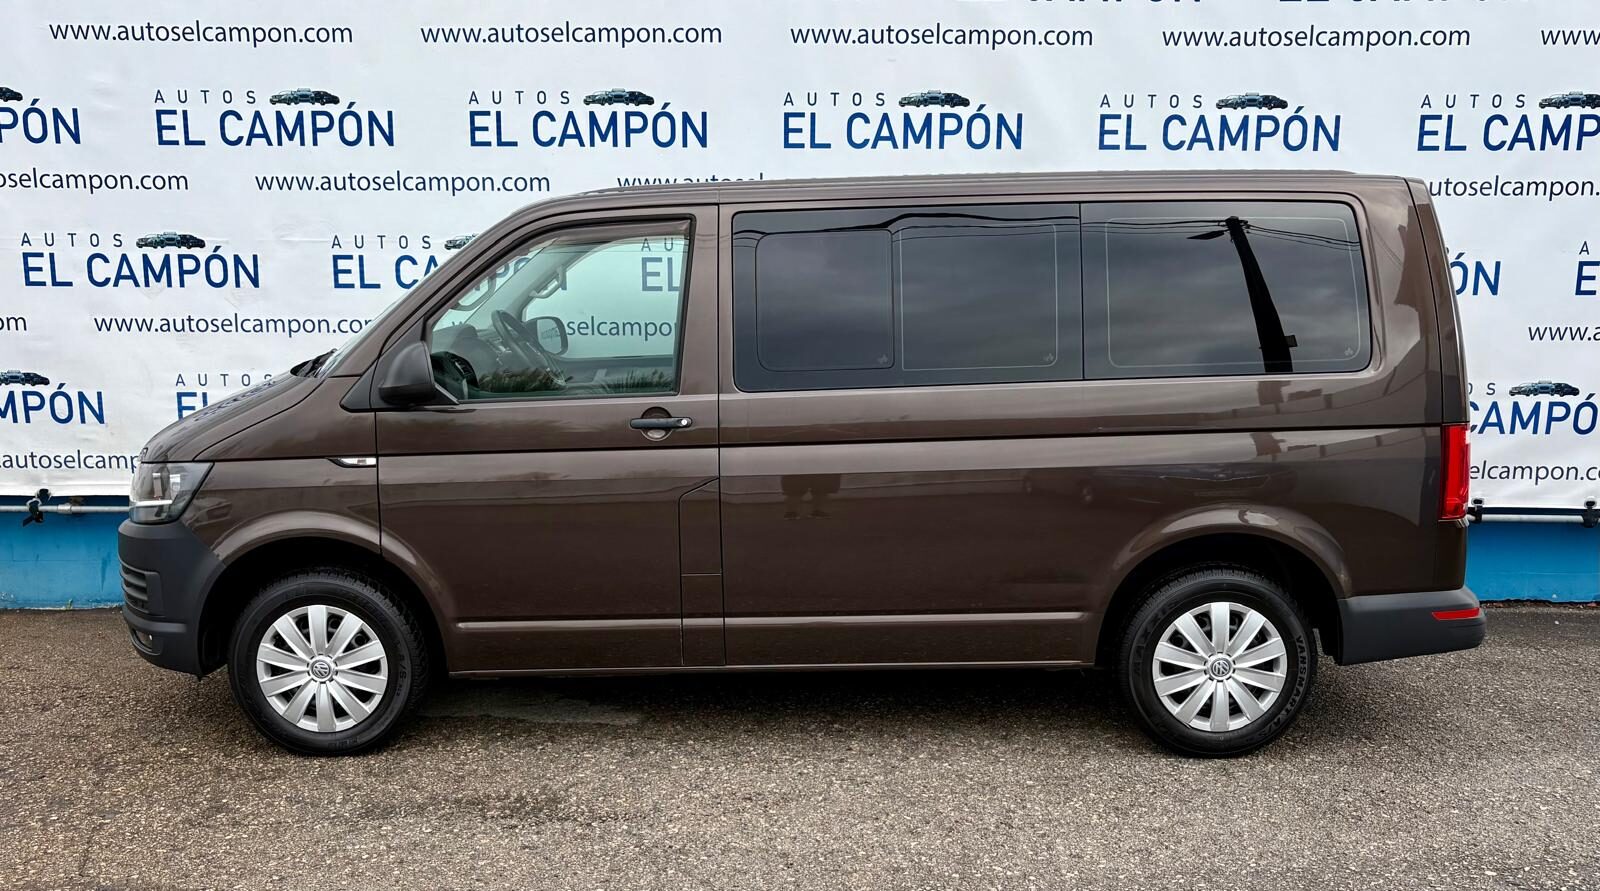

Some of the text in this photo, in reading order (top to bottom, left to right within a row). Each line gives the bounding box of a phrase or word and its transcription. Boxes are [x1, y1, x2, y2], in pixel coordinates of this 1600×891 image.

[49, 20, 352, 48] www.autoselcampon.com
[421, 21, 721, 48] www.autoselcampon.com
[791, 23, 1092, 50] www.autoselcampon.com
[1163, 25, 1470, 52] www.autoselcampon.com
[155, 90, 255, 104] AUTOS
[469, 91, 569, 104] AUTOS
[784, 92, 884, 106] AUTOS
[1100, 94, 1202, 108] AUTOS
[1421, 94, 1525, 108] AUTOS
[156, 101, 394, 146] EL CAMPÓN
[470, 102, 707, 148] EL CAMPÓN
[784, 104, 1022, 149] EL CAMPÓN
[1099, 105, 1340, 151] EL CAMPÓN
[1417, 115, 1466, 151] EL
[255, 170, 549, 196] www.autoselcampon.com
[21, 233, 122, 247] AUTOS
[332, 235, 431, 249] AUTOS
[22, 246, 259, 288] EL CAMPÓN
[332, 255, 381, 289] EL
[1282, 635, 1308, 716] VANSMART
